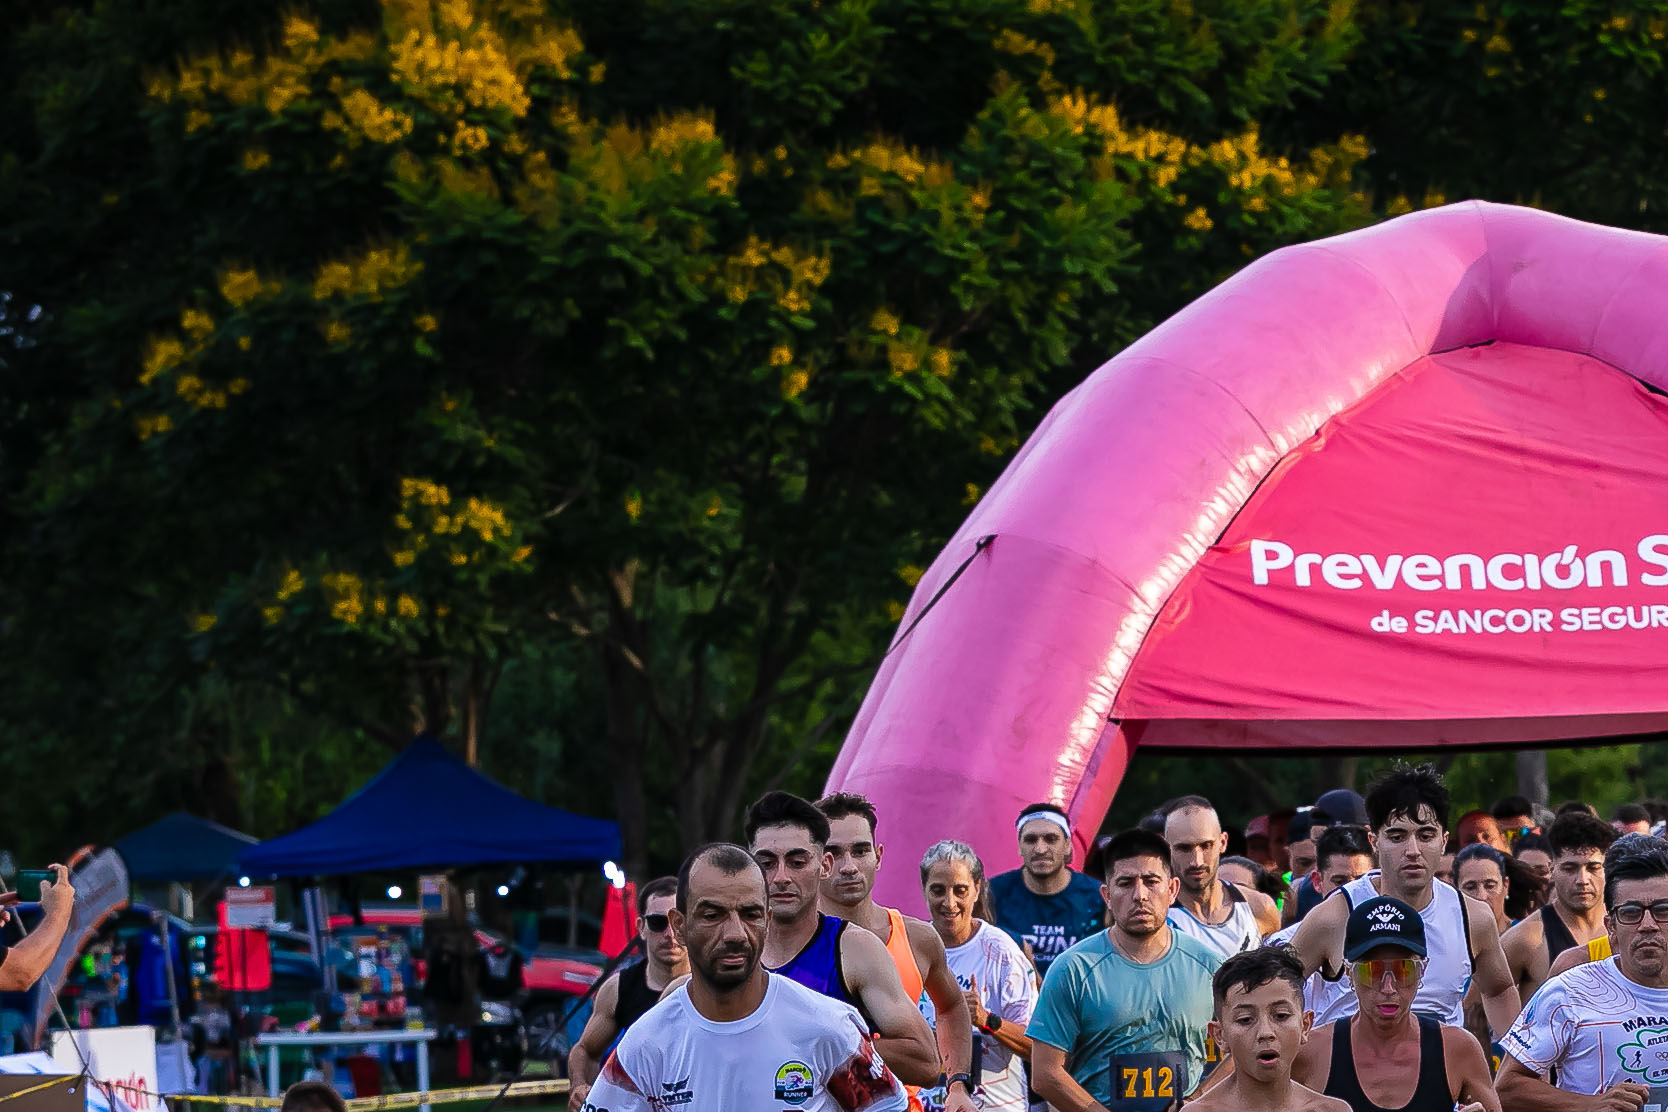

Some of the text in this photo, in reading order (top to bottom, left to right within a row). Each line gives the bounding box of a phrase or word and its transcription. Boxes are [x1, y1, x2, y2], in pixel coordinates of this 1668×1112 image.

[1250, 538, 1628, 591] Prevención
[1370, 609, 1408, 633] de
[1414, 608, 1553, 634] SANCOR
[1031, 924, 1065, 936] TEAM
[1369, 922, 1401, 932] ARMANI
[1123, 1066, 1174, 1098] 712
